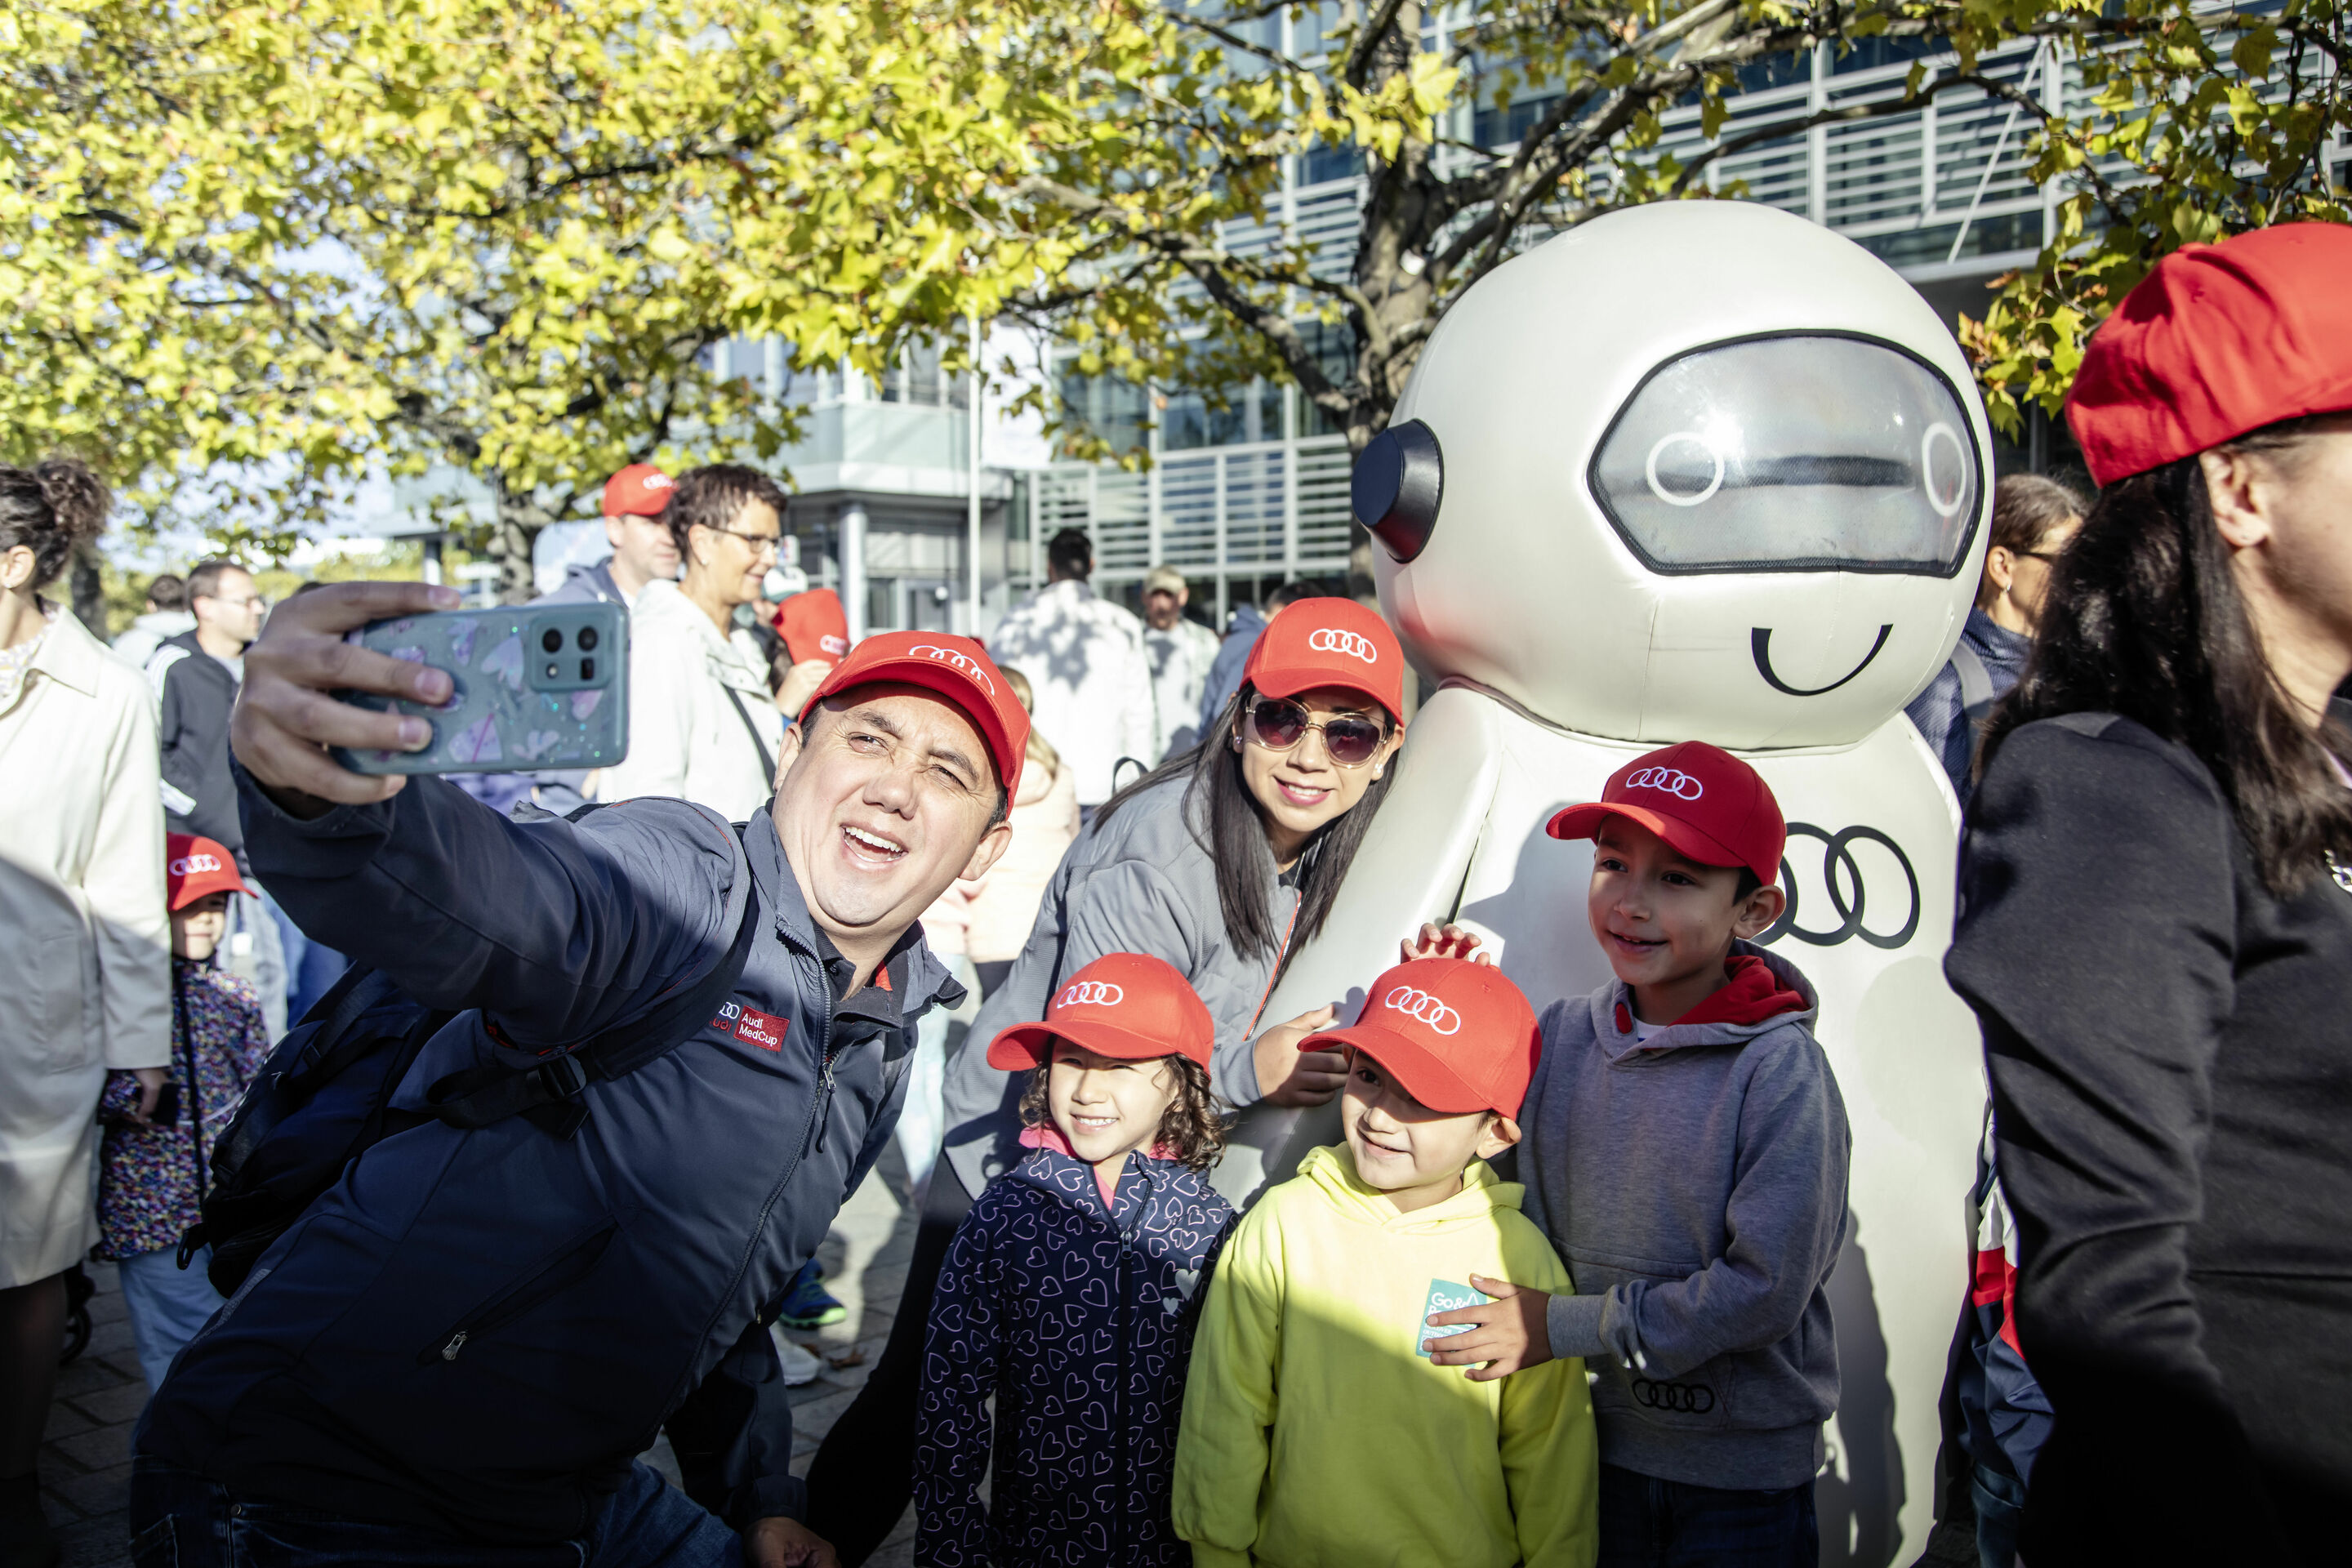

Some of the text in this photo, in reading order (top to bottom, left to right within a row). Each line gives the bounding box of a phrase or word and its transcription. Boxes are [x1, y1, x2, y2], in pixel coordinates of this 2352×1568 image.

[710, 1018, 732, 1033] udi
[742, 1013, 763, 1029] Audi
[738, 1023, 777, 1047] MedCup
